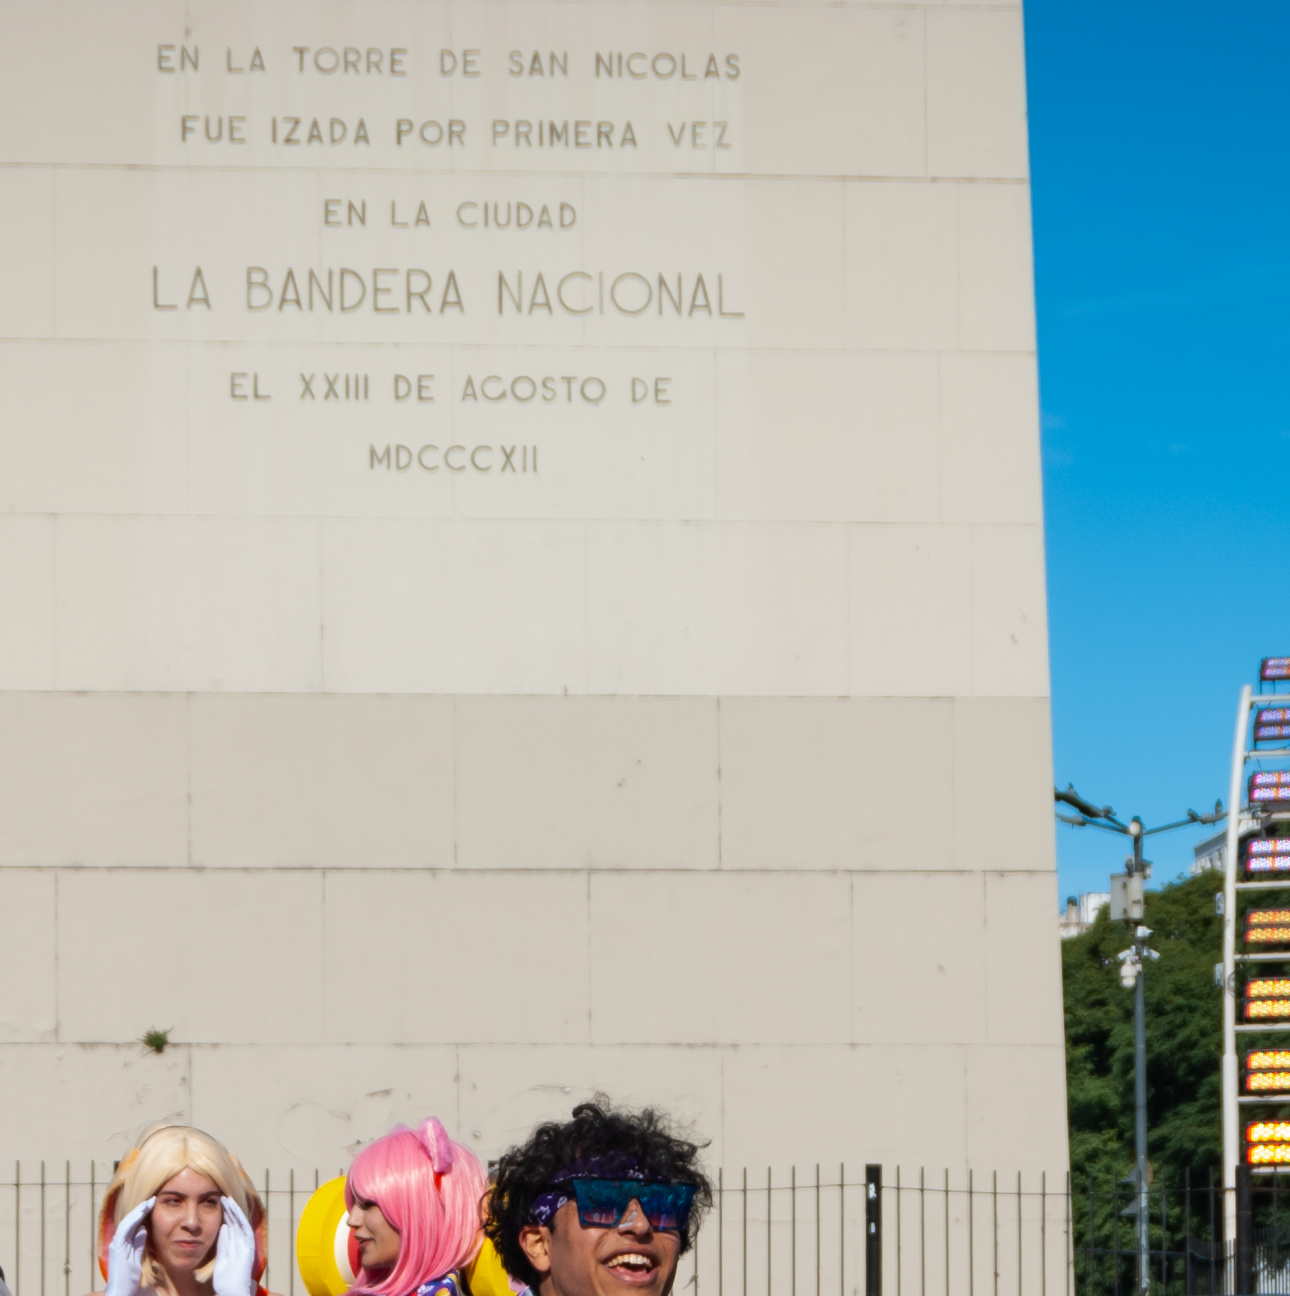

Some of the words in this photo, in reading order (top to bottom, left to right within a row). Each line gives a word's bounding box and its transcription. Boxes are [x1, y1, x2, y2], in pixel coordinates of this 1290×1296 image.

[157, 44, 199, 73] EN
[226, 46, 265, 74] LA
[293, 46, 407, 77] TORRE
[440, 49, 480, 78] DE
[509, 50, 568, 77] SAN
[595, 51, 740, 81] NICOLAS
[181, 115, 246, 144] FUE
[271, 116, 370, 146] IZADA
[396, 118, 466, 148] POR
[492, 119, 637, 149] PRIMERA
[667, 121, 731, 149] VEZ
[324, 199, 366, 227] EN
[391, 200, 430, 228] LA
[456, 201, 577, 230] CIUDAD
[152, 266, 211, 311] LA
[246, 266, 464, 315] BANDERA
[498, 270, 745, 319] NACIONAL
[230, 372, 271, 401] EL
[300, 373, 369, 401] XXIII
[394, 374, 434, 403] DE
[462, 375, 606, 406] AGOSTO
[631, 377, 671, 406] DE
[369, 444, 538, 474] MDCCCXII
